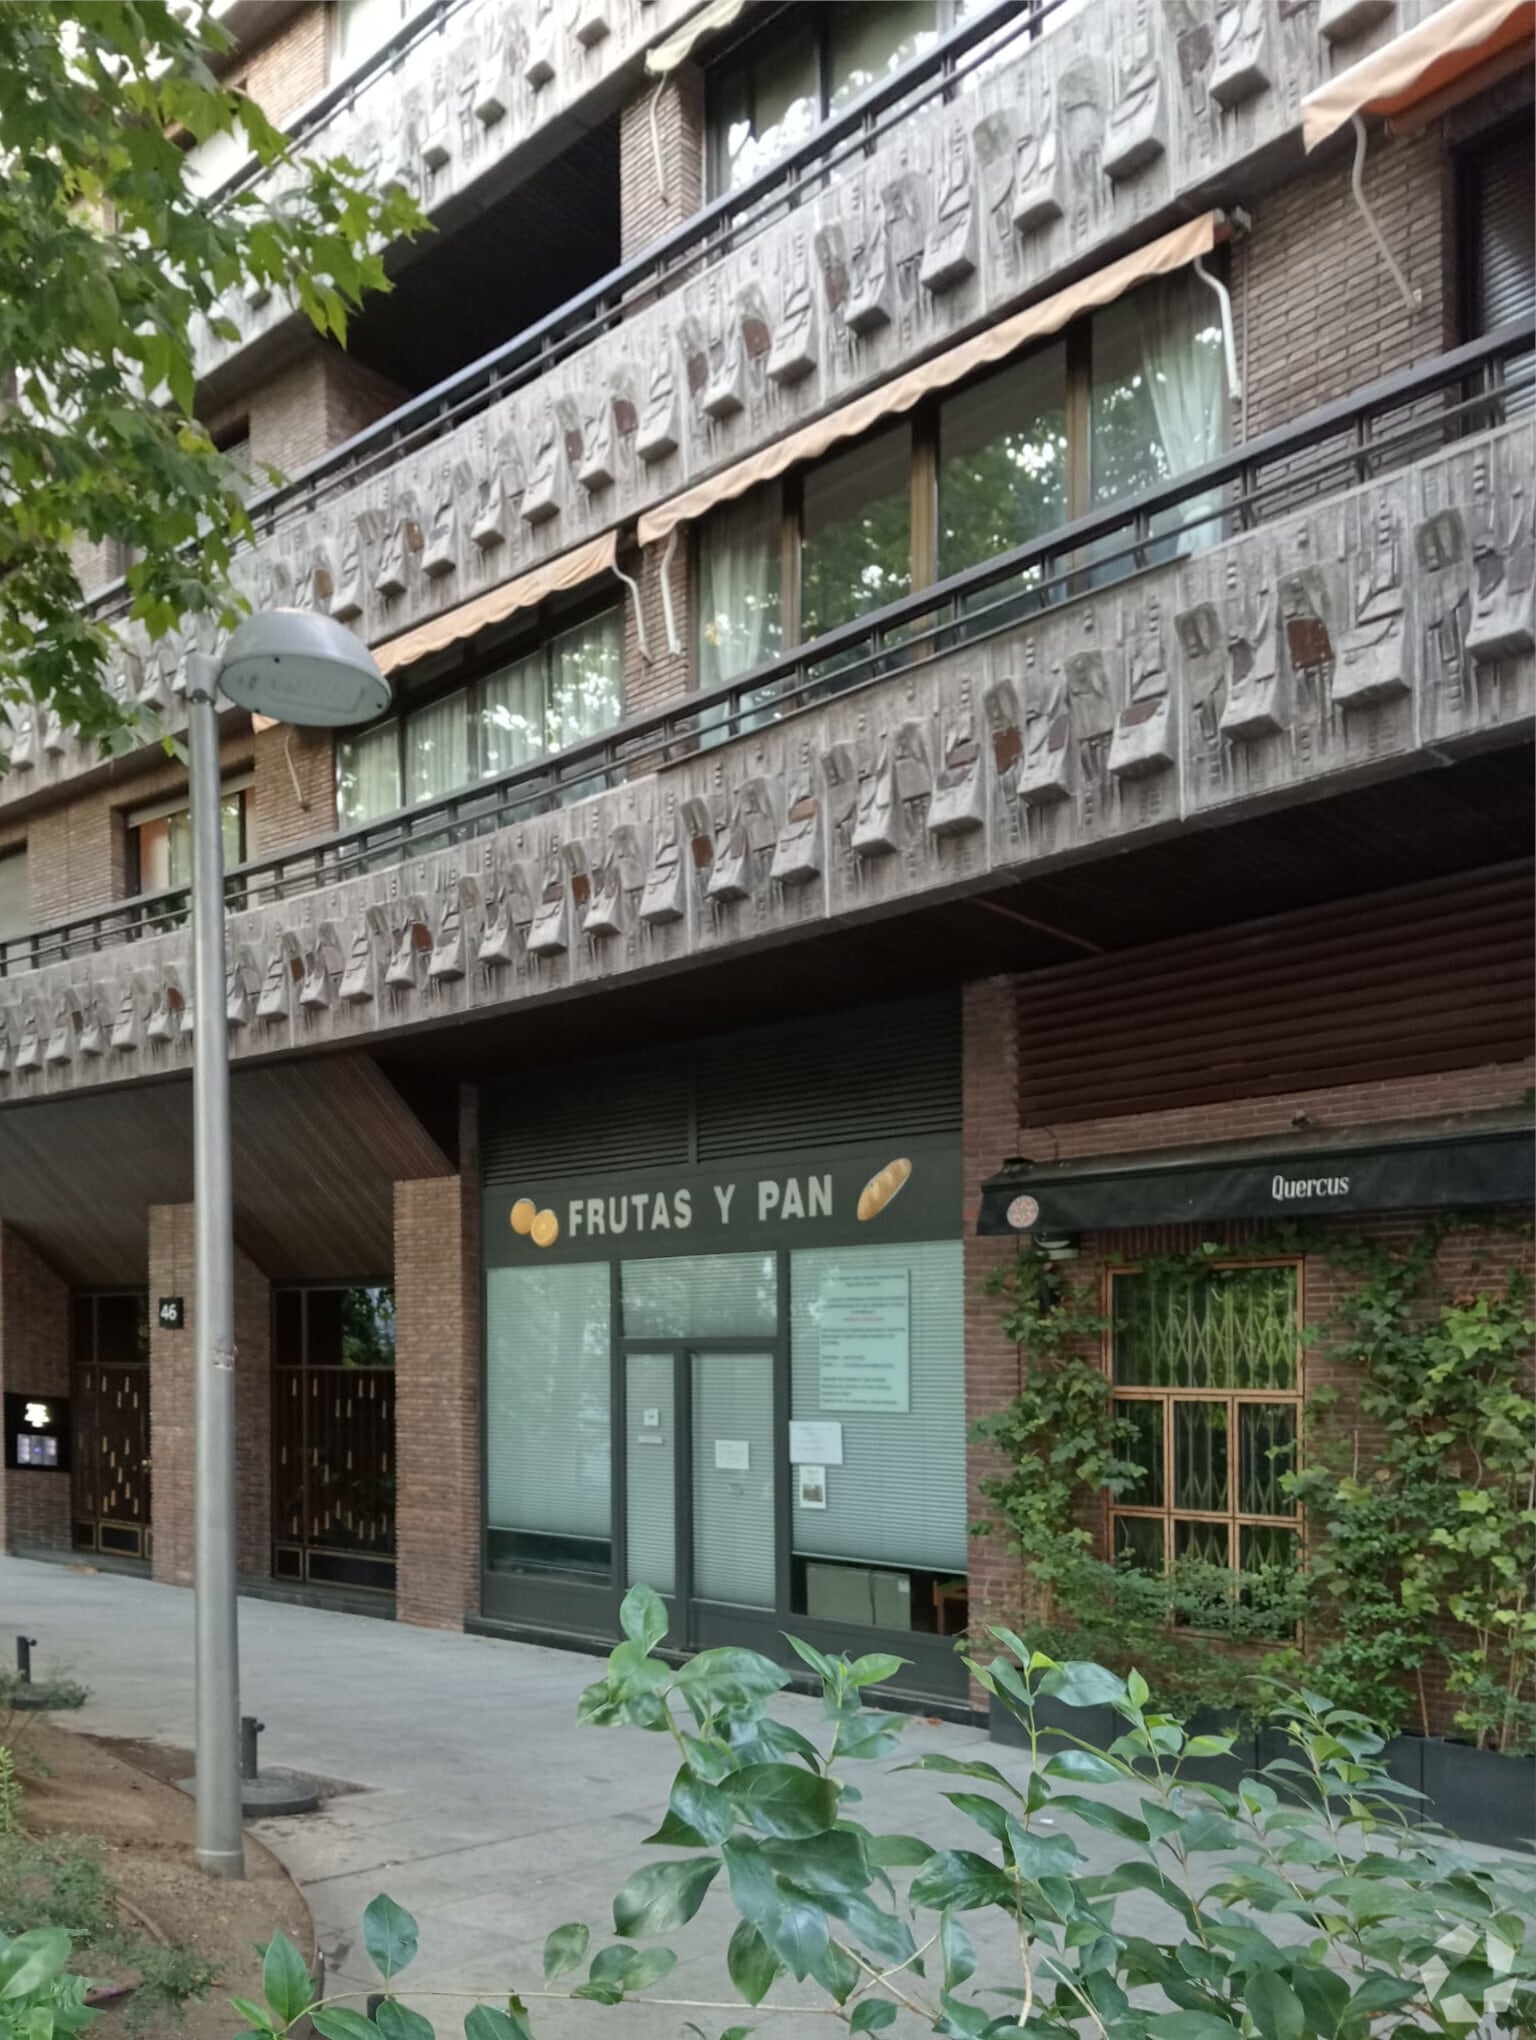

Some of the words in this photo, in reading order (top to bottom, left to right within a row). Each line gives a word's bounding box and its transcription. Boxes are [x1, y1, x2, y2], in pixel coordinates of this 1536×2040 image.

[1271, 1174, 1350, 1201] Quercus
[568, 1188, 693, 1237] FRUTAS
[713, 1183, 736, 1224] Y
[758, 1174, 833, 1221] PAN
[160, 1303, 177, 1321] 46
